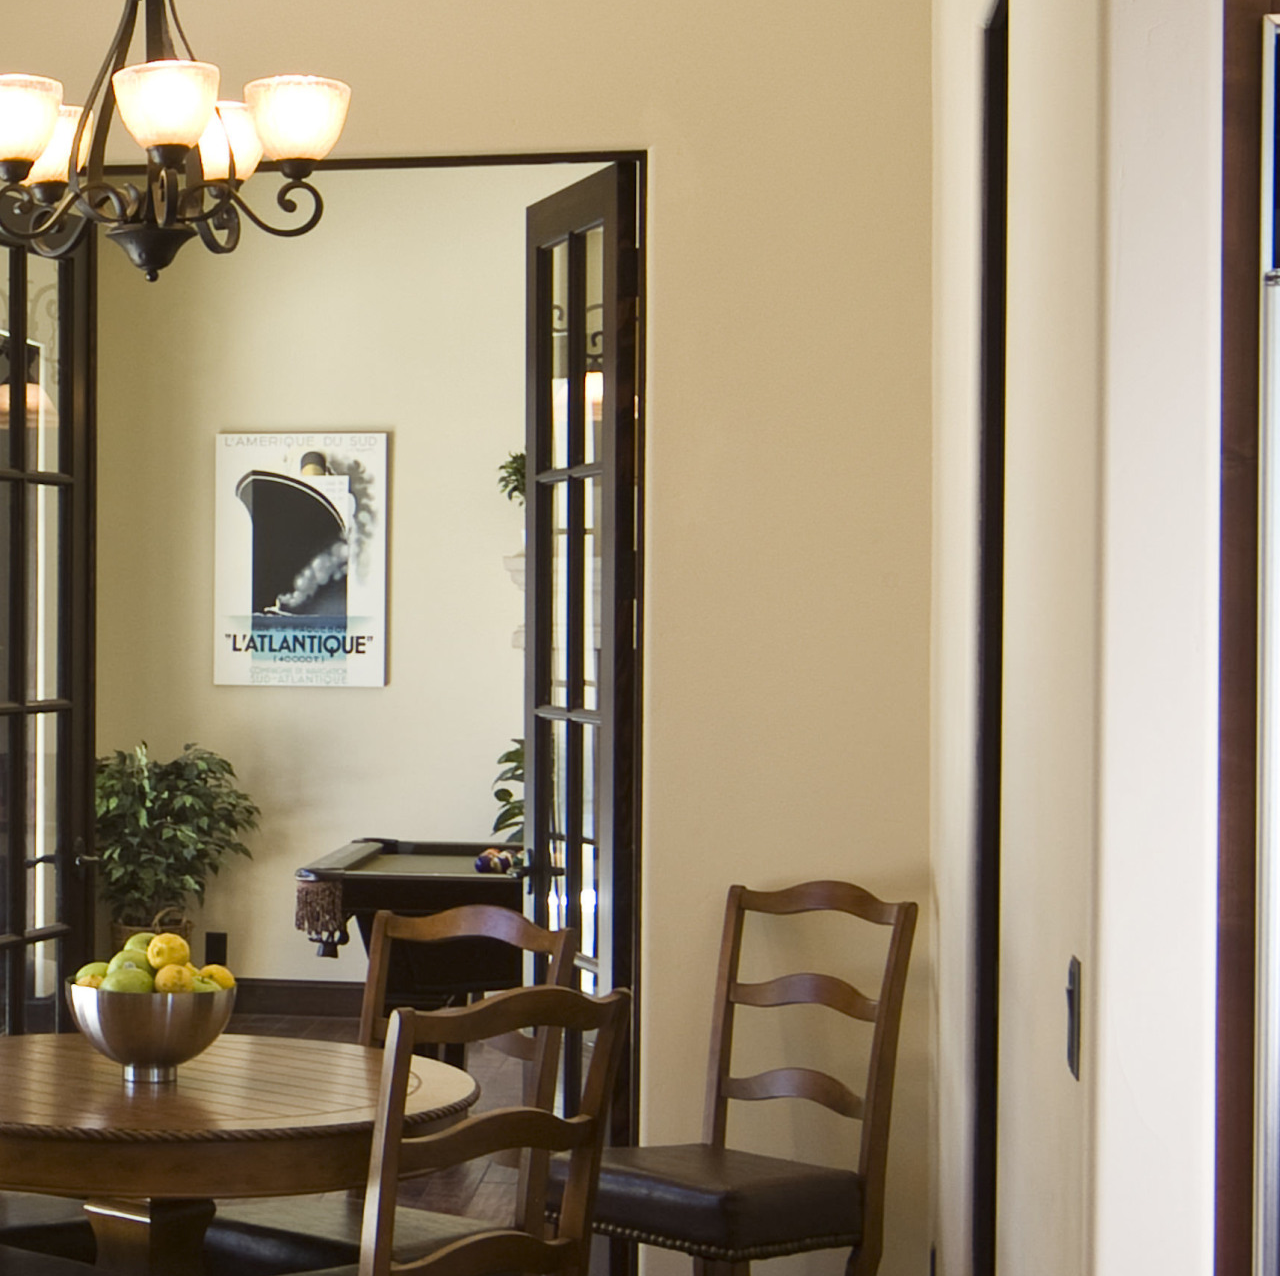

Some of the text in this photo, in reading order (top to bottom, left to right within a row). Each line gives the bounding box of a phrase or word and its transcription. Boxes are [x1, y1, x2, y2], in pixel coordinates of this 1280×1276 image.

[323, 436, 343, 447] DU
[349, 436, 378, 447] SUD
[225, 633, 373, 657] "L'ATLANTIQUE"
